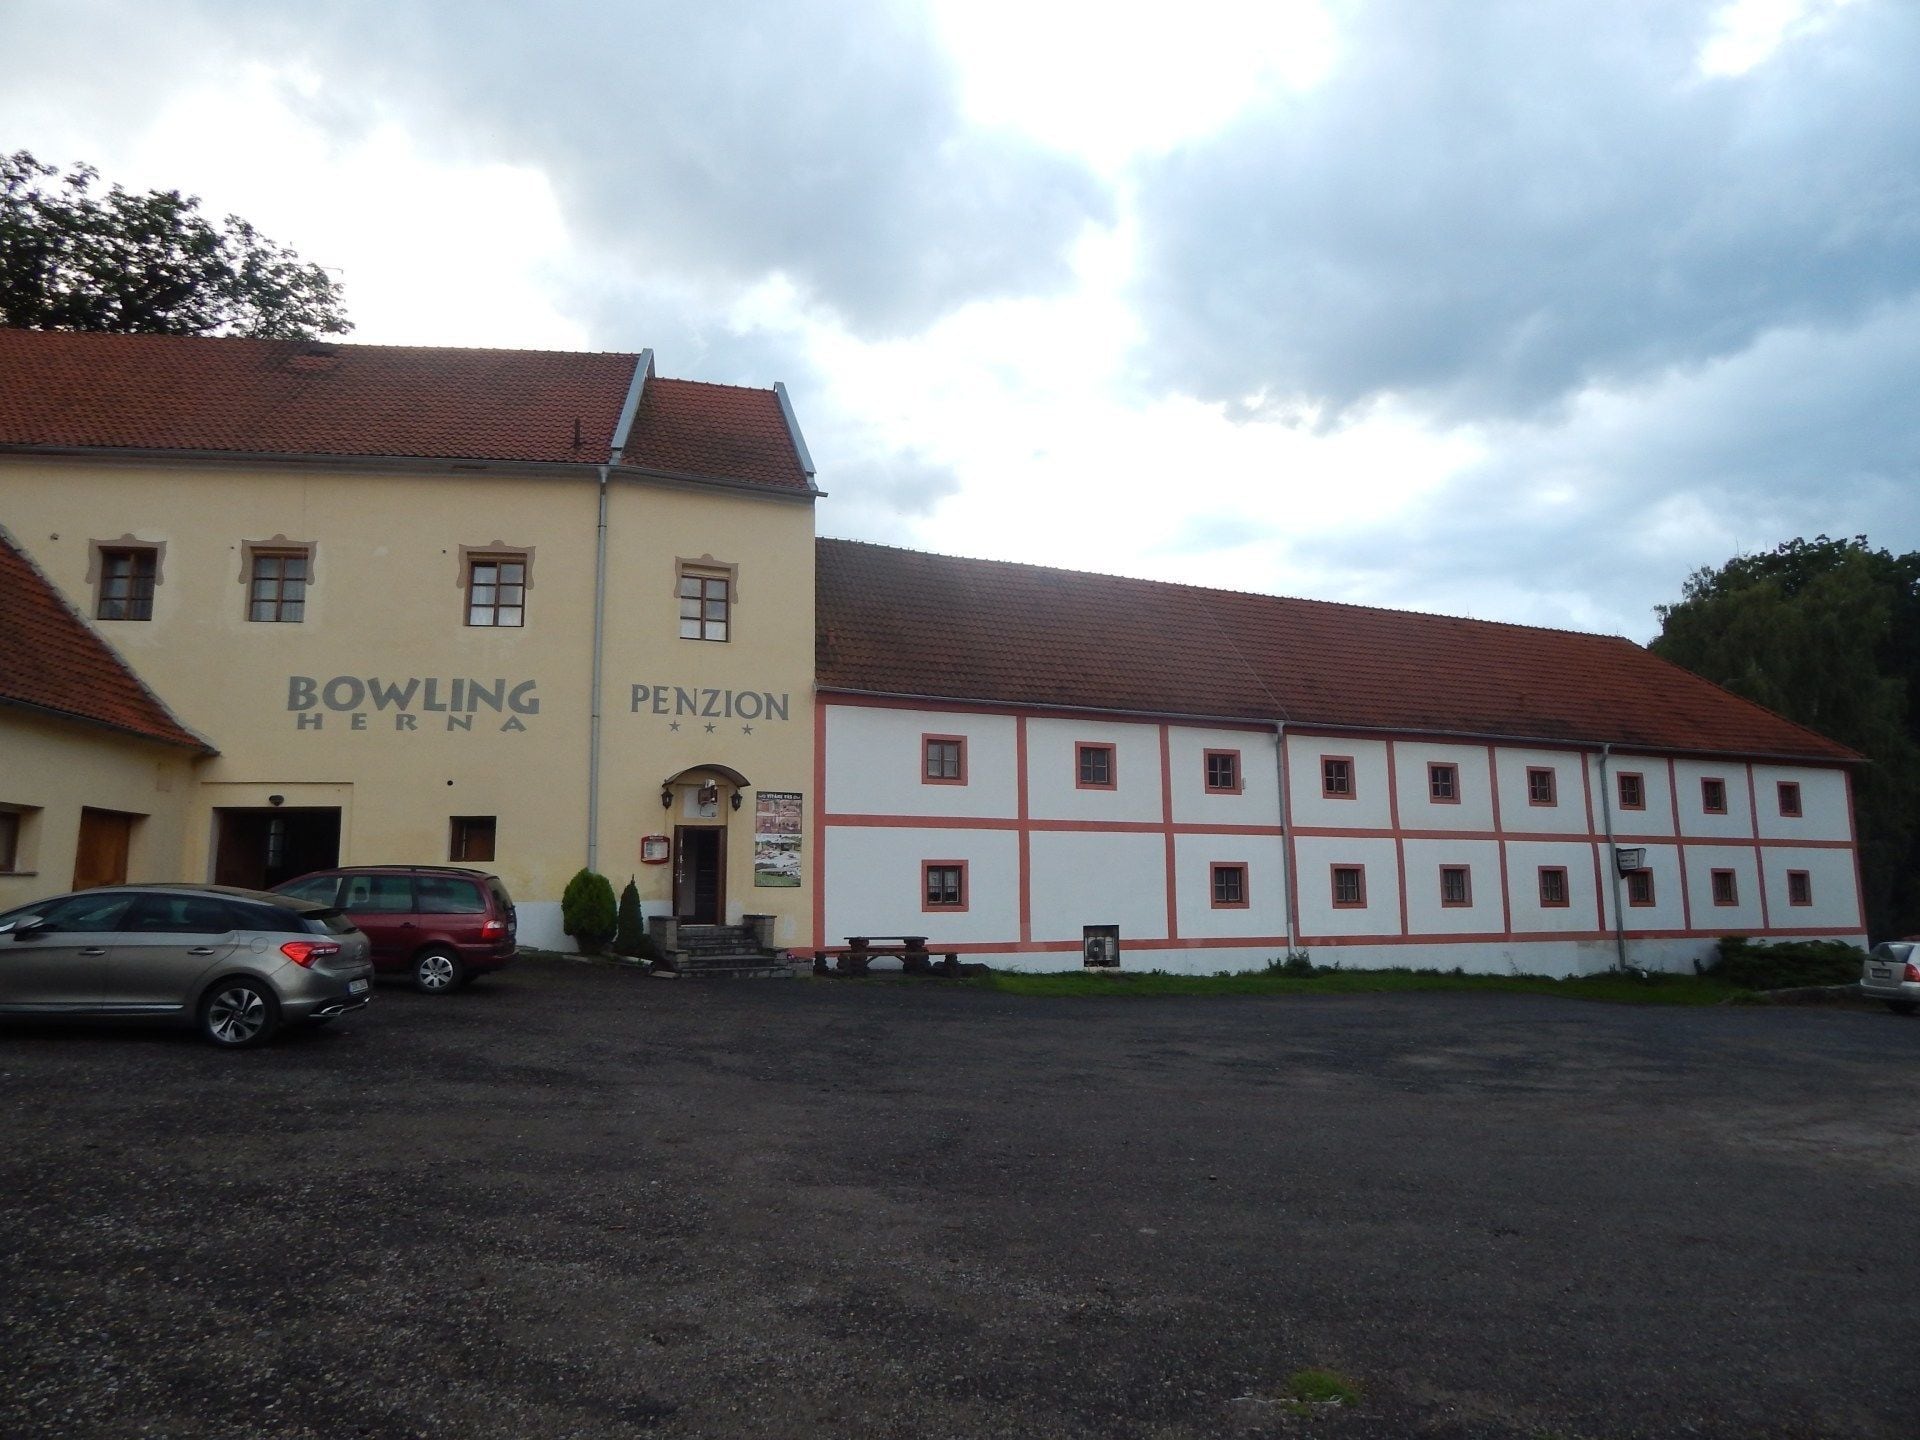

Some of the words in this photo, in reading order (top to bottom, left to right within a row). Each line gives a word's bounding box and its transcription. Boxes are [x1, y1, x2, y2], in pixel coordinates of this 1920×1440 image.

[287, 675, 540, 714] BOWLING
[631, 684, 789, 721] PENZION
[297, 712, 527, 732] HERNA
